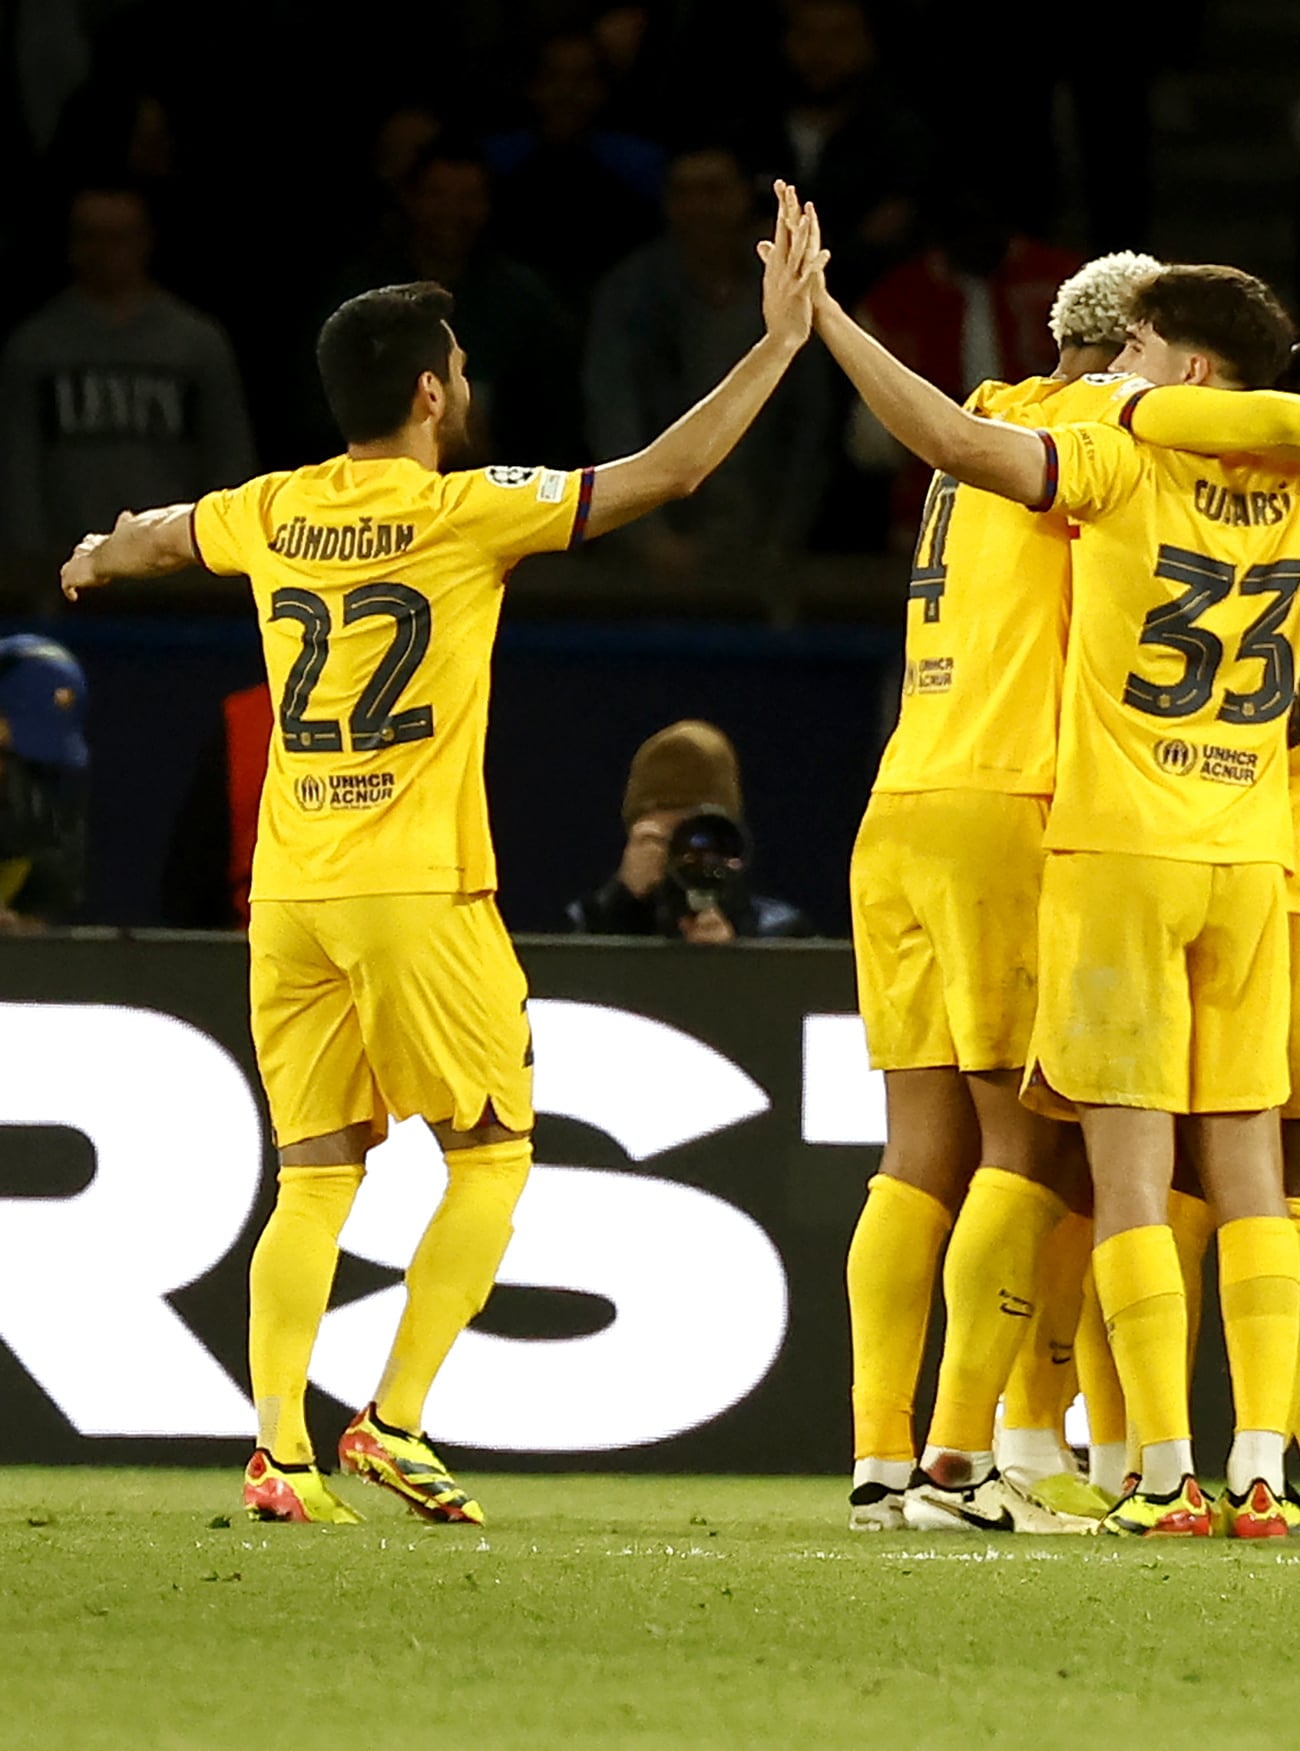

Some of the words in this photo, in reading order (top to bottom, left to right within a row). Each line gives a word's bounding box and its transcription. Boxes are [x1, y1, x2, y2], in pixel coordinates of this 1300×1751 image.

[267, 582, 434, 753] 22
[1203, 744, 1258, 767] UNHCR
[329, 772, 394, 790] UNHCR
[330, 787, 393, 804] ACNUR
